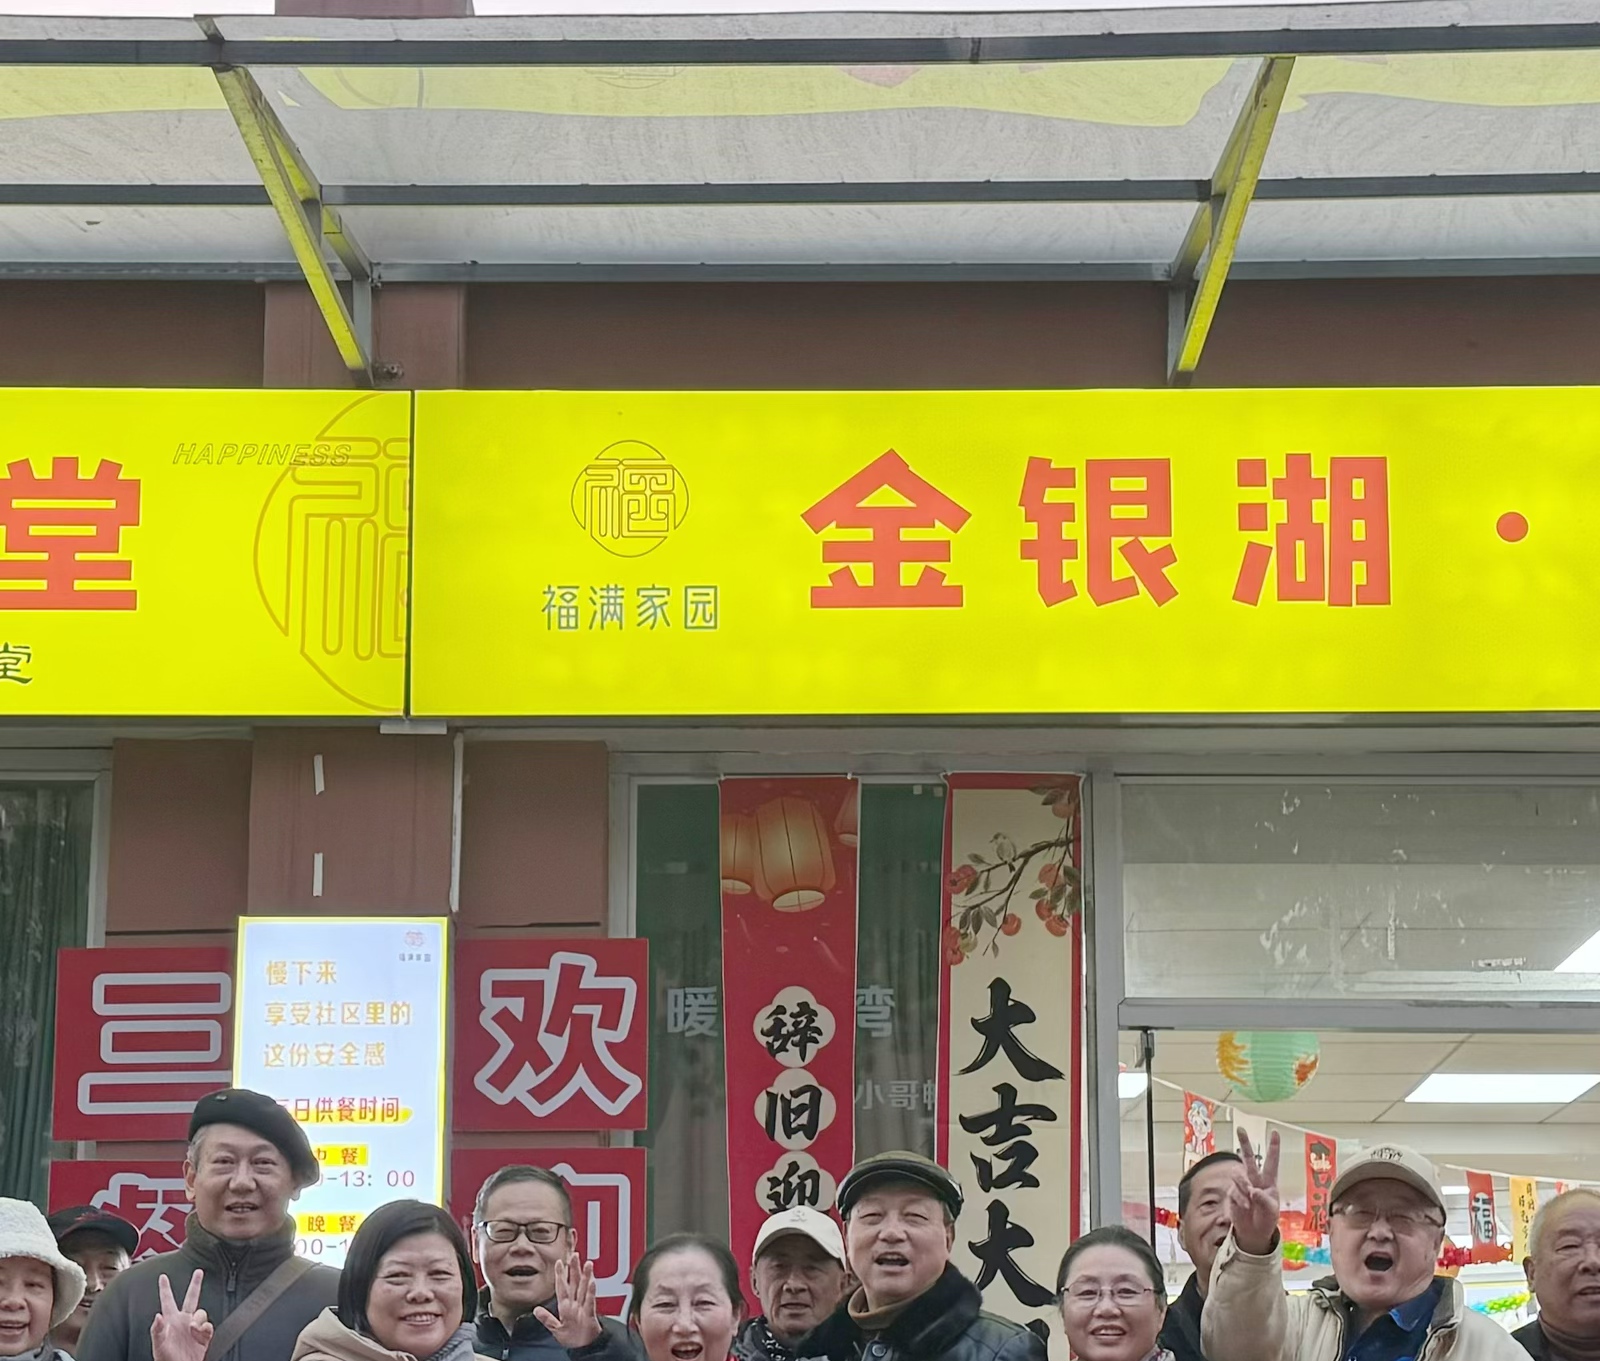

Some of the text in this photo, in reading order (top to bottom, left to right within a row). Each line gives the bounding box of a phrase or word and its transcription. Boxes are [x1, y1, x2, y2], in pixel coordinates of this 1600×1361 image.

[173, 442, 352, 467] HAPPINESS
[541, 583, 719, 631] 福满家园
[266, 960, 338, 985] 慢下来
[264, 1001, 411, 1026] 享受社区里的
[264, 1042, 386, 1068] 这份安全感
[953, 976, 1066, 1350] 大吉大
